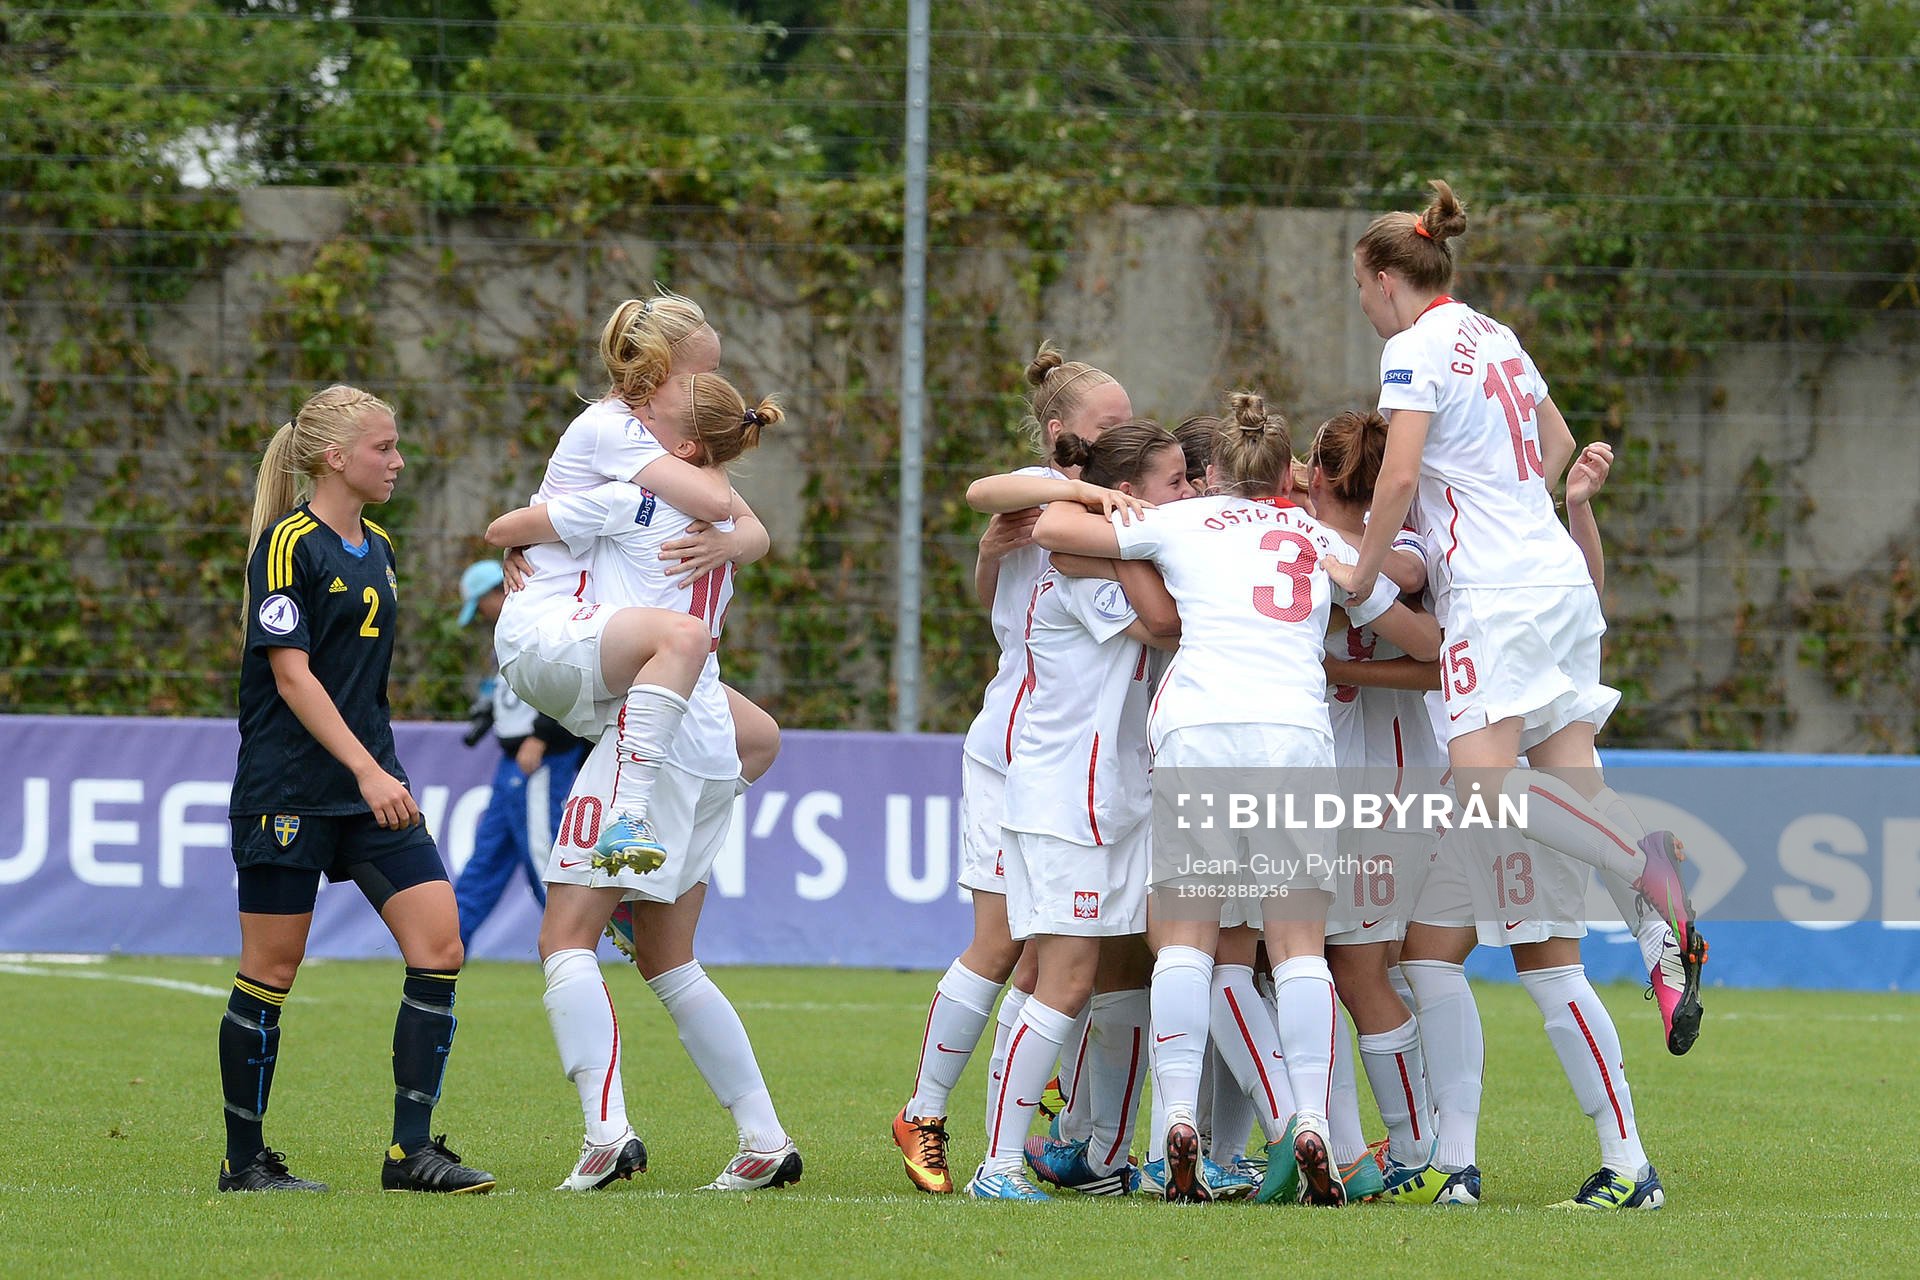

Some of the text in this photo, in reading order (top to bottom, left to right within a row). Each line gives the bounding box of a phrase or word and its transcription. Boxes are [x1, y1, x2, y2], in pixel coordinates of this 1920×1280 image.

[1483, 357, 1544, 481] 15
[1253, 530, 1318, 622] 3
[360, 586, 380, 637] 2
[1440, 640, 1478, 702] 15
[559, 796, 602, 849] 10
[1492, 851, 1536, 909] 13
